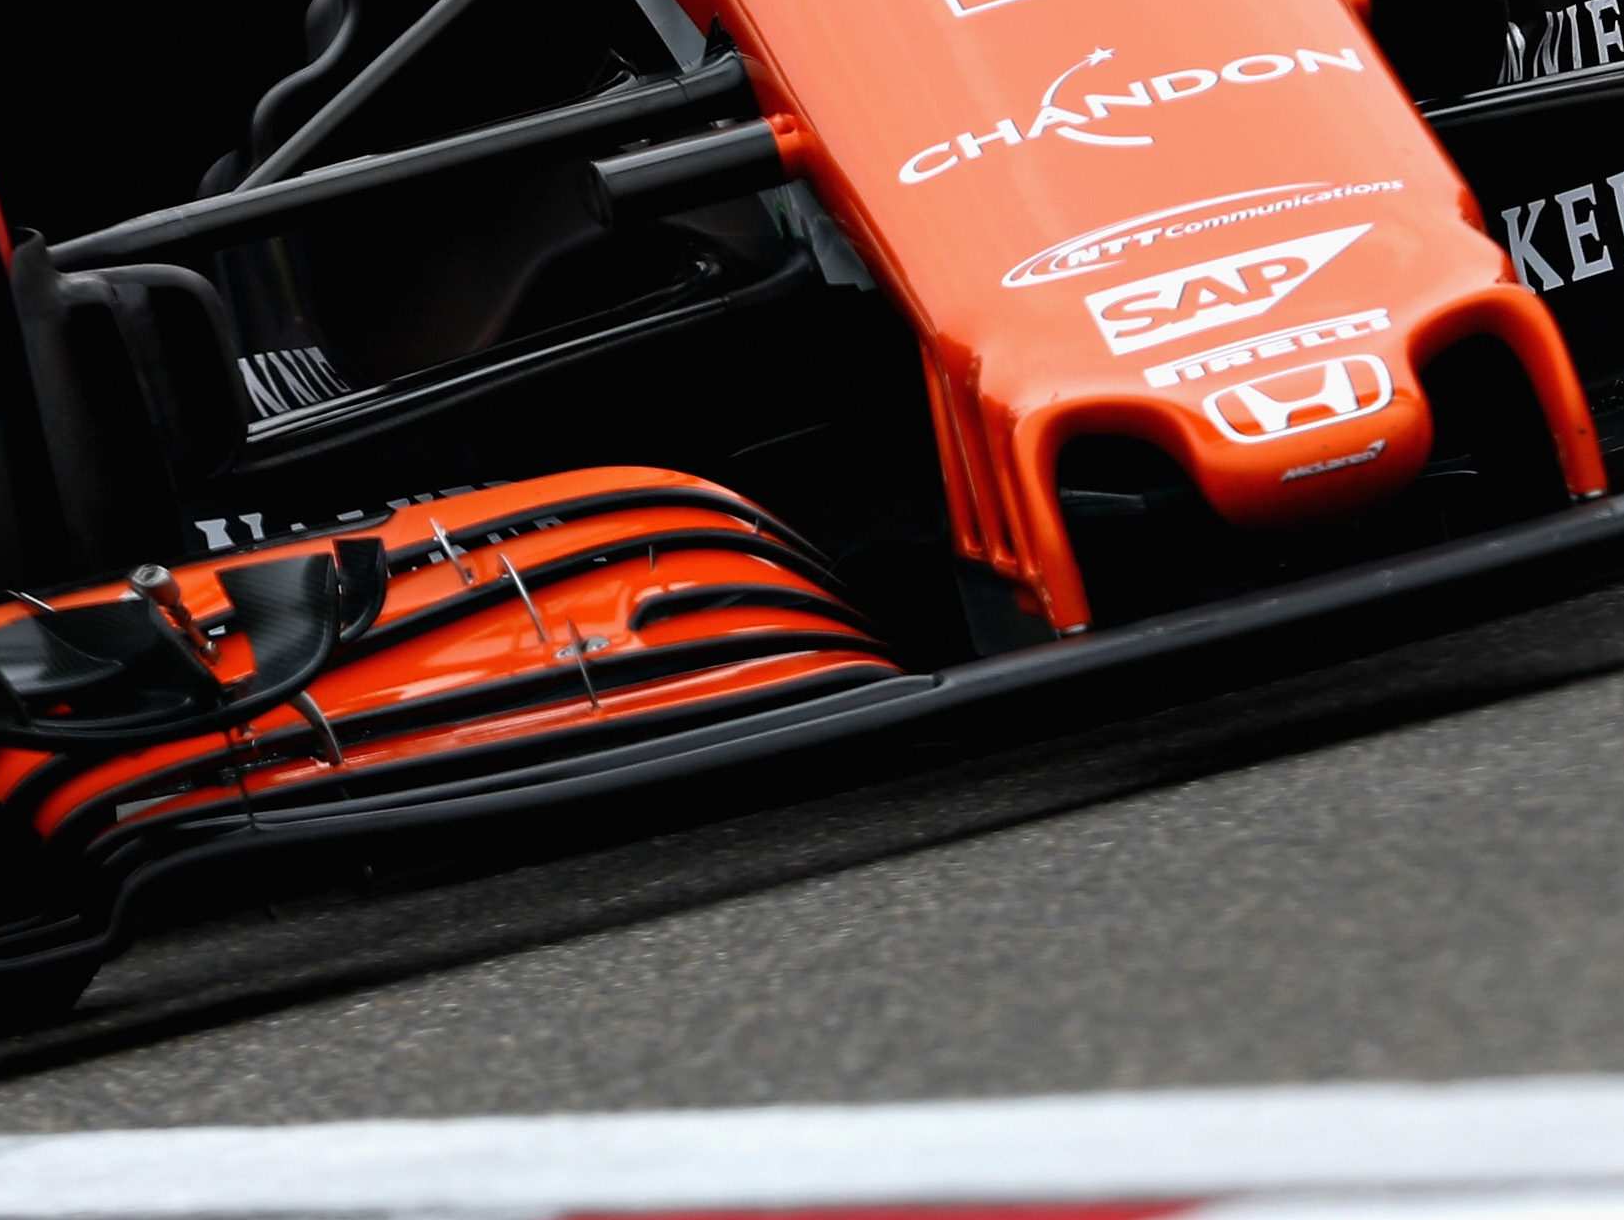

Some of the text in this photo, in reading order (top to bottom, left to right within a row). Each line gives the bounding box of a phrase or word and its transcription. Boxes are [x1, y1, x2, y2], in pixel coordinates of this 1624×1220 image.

[898, 47, 1365, 184] CHANDON
[1065, 179, 1405, 269] NTT Communications
[1100, 255, 1311, 340] SAP
[1143, 307, 1392, 388] PIRELLI
